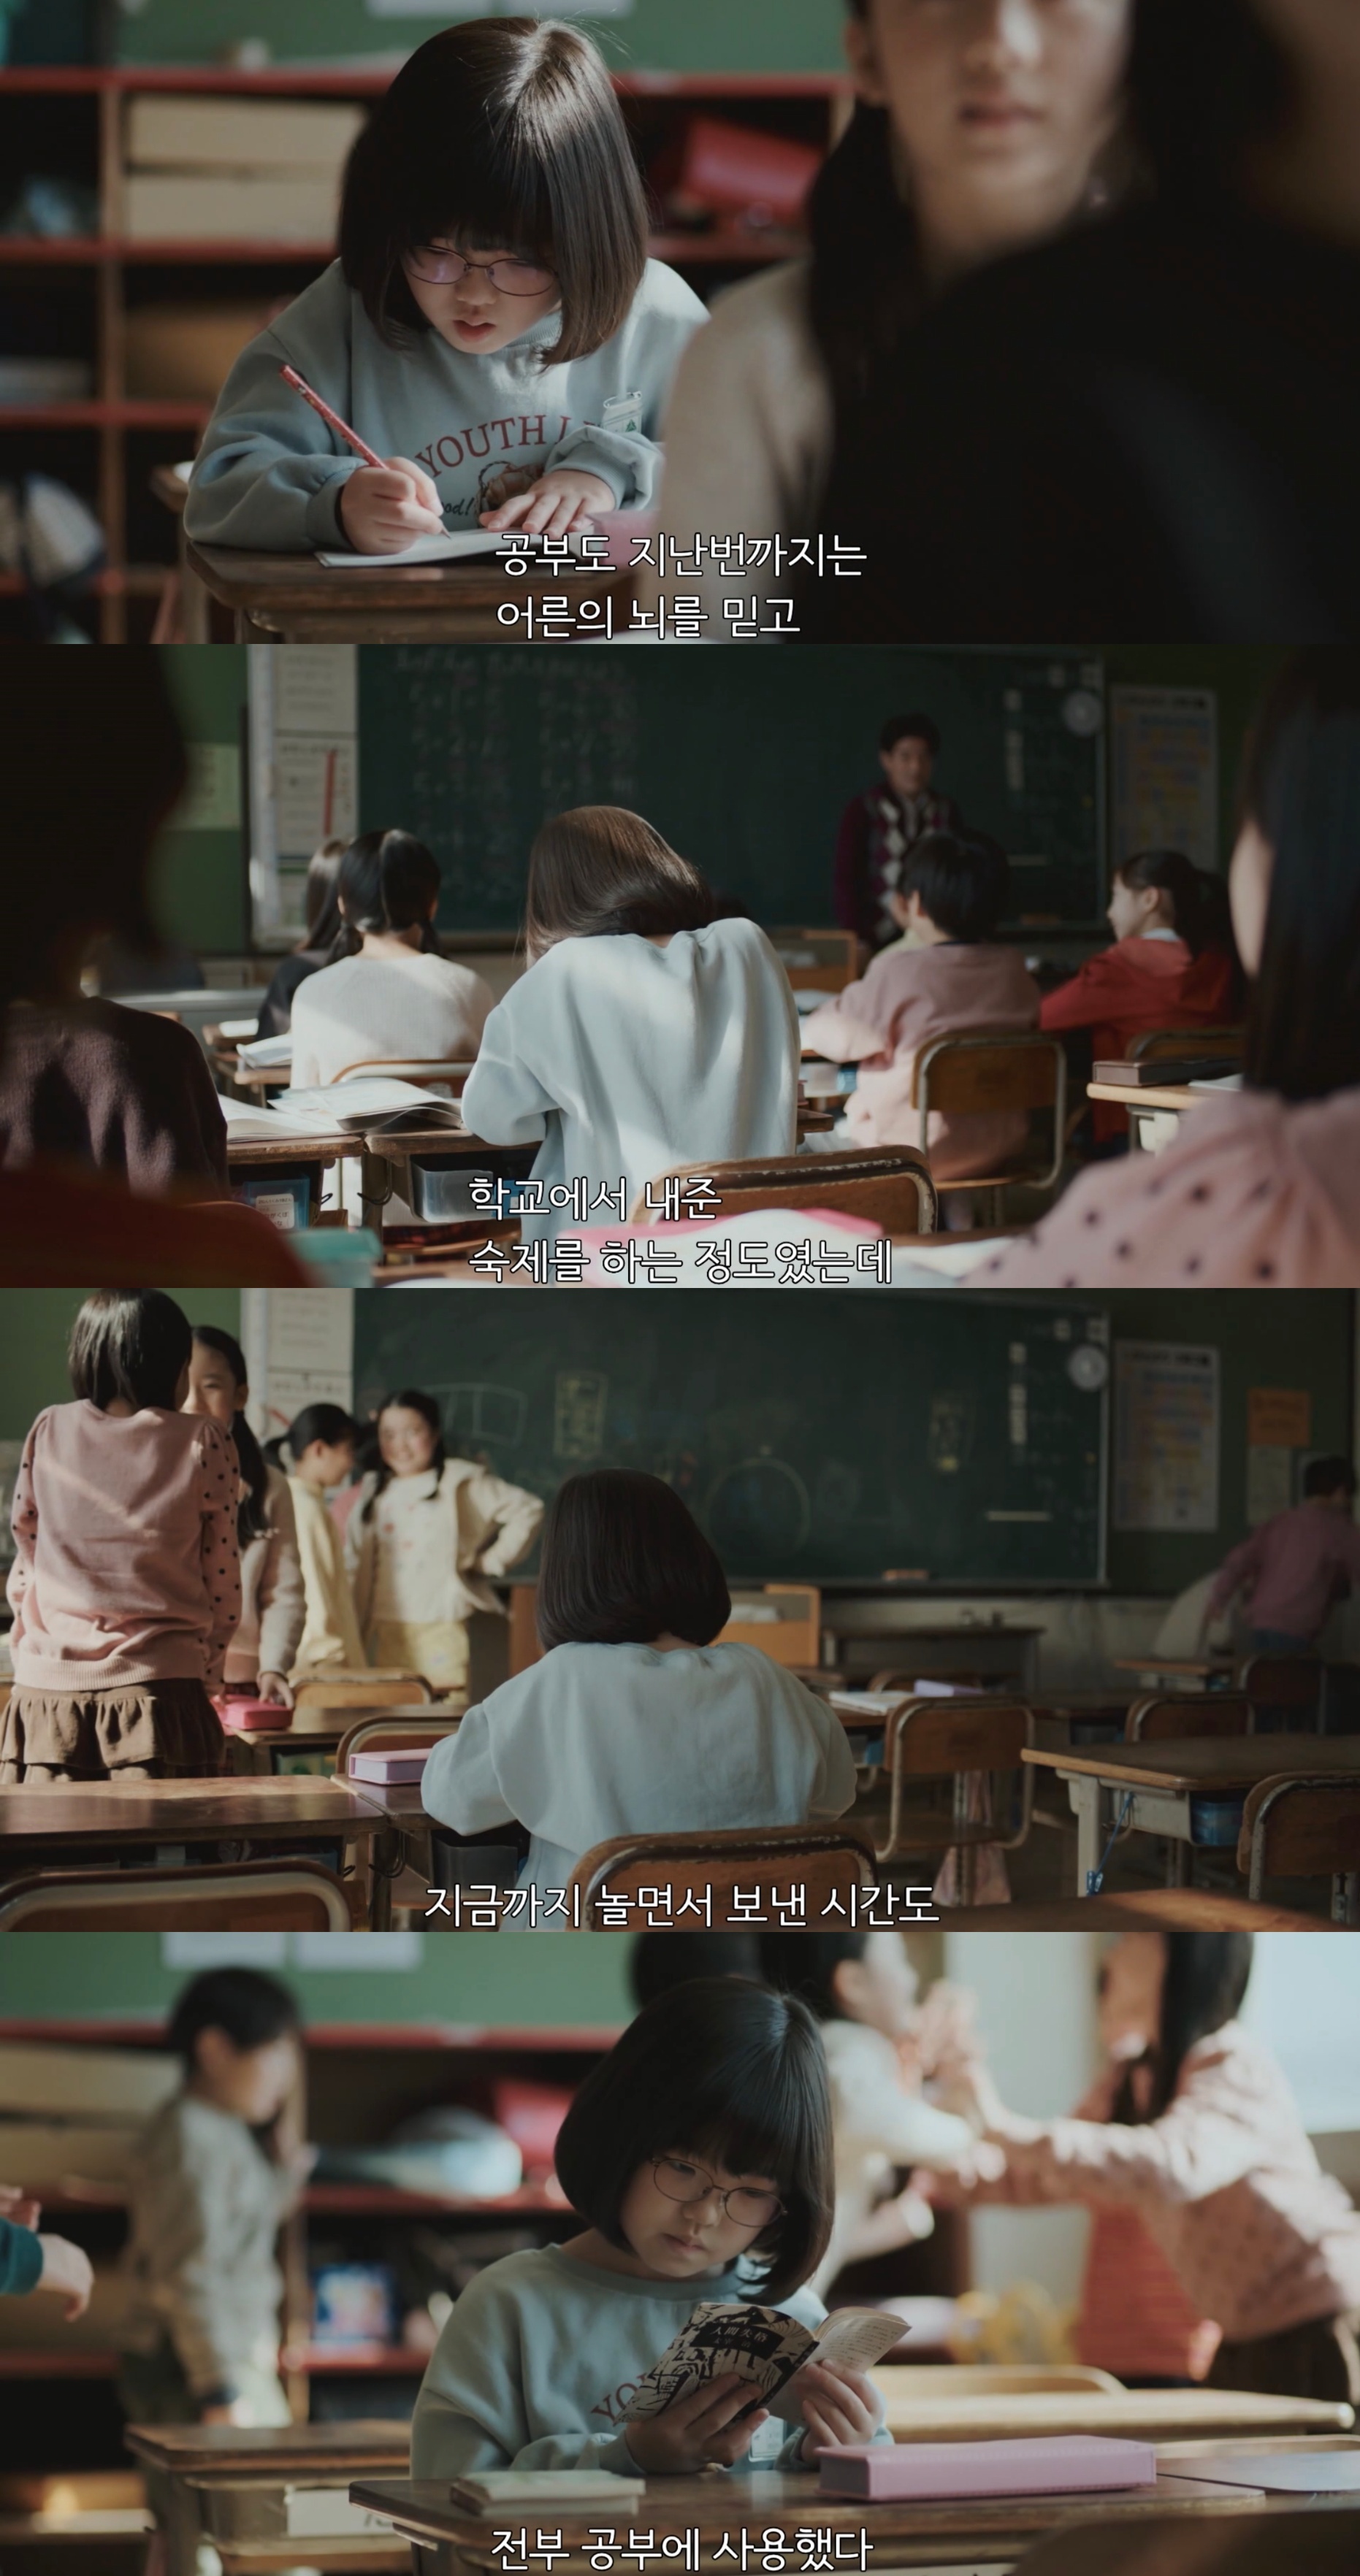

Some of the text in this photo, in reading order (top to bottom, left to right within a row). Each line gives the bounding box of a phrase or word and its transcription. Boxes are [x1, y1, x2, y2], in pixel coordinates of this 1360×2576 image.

[415, 414, 547, 478] YOUTH
[709, 2326, 769, 2343] 人間失格
[590, 2372, 648, 2428] YO
